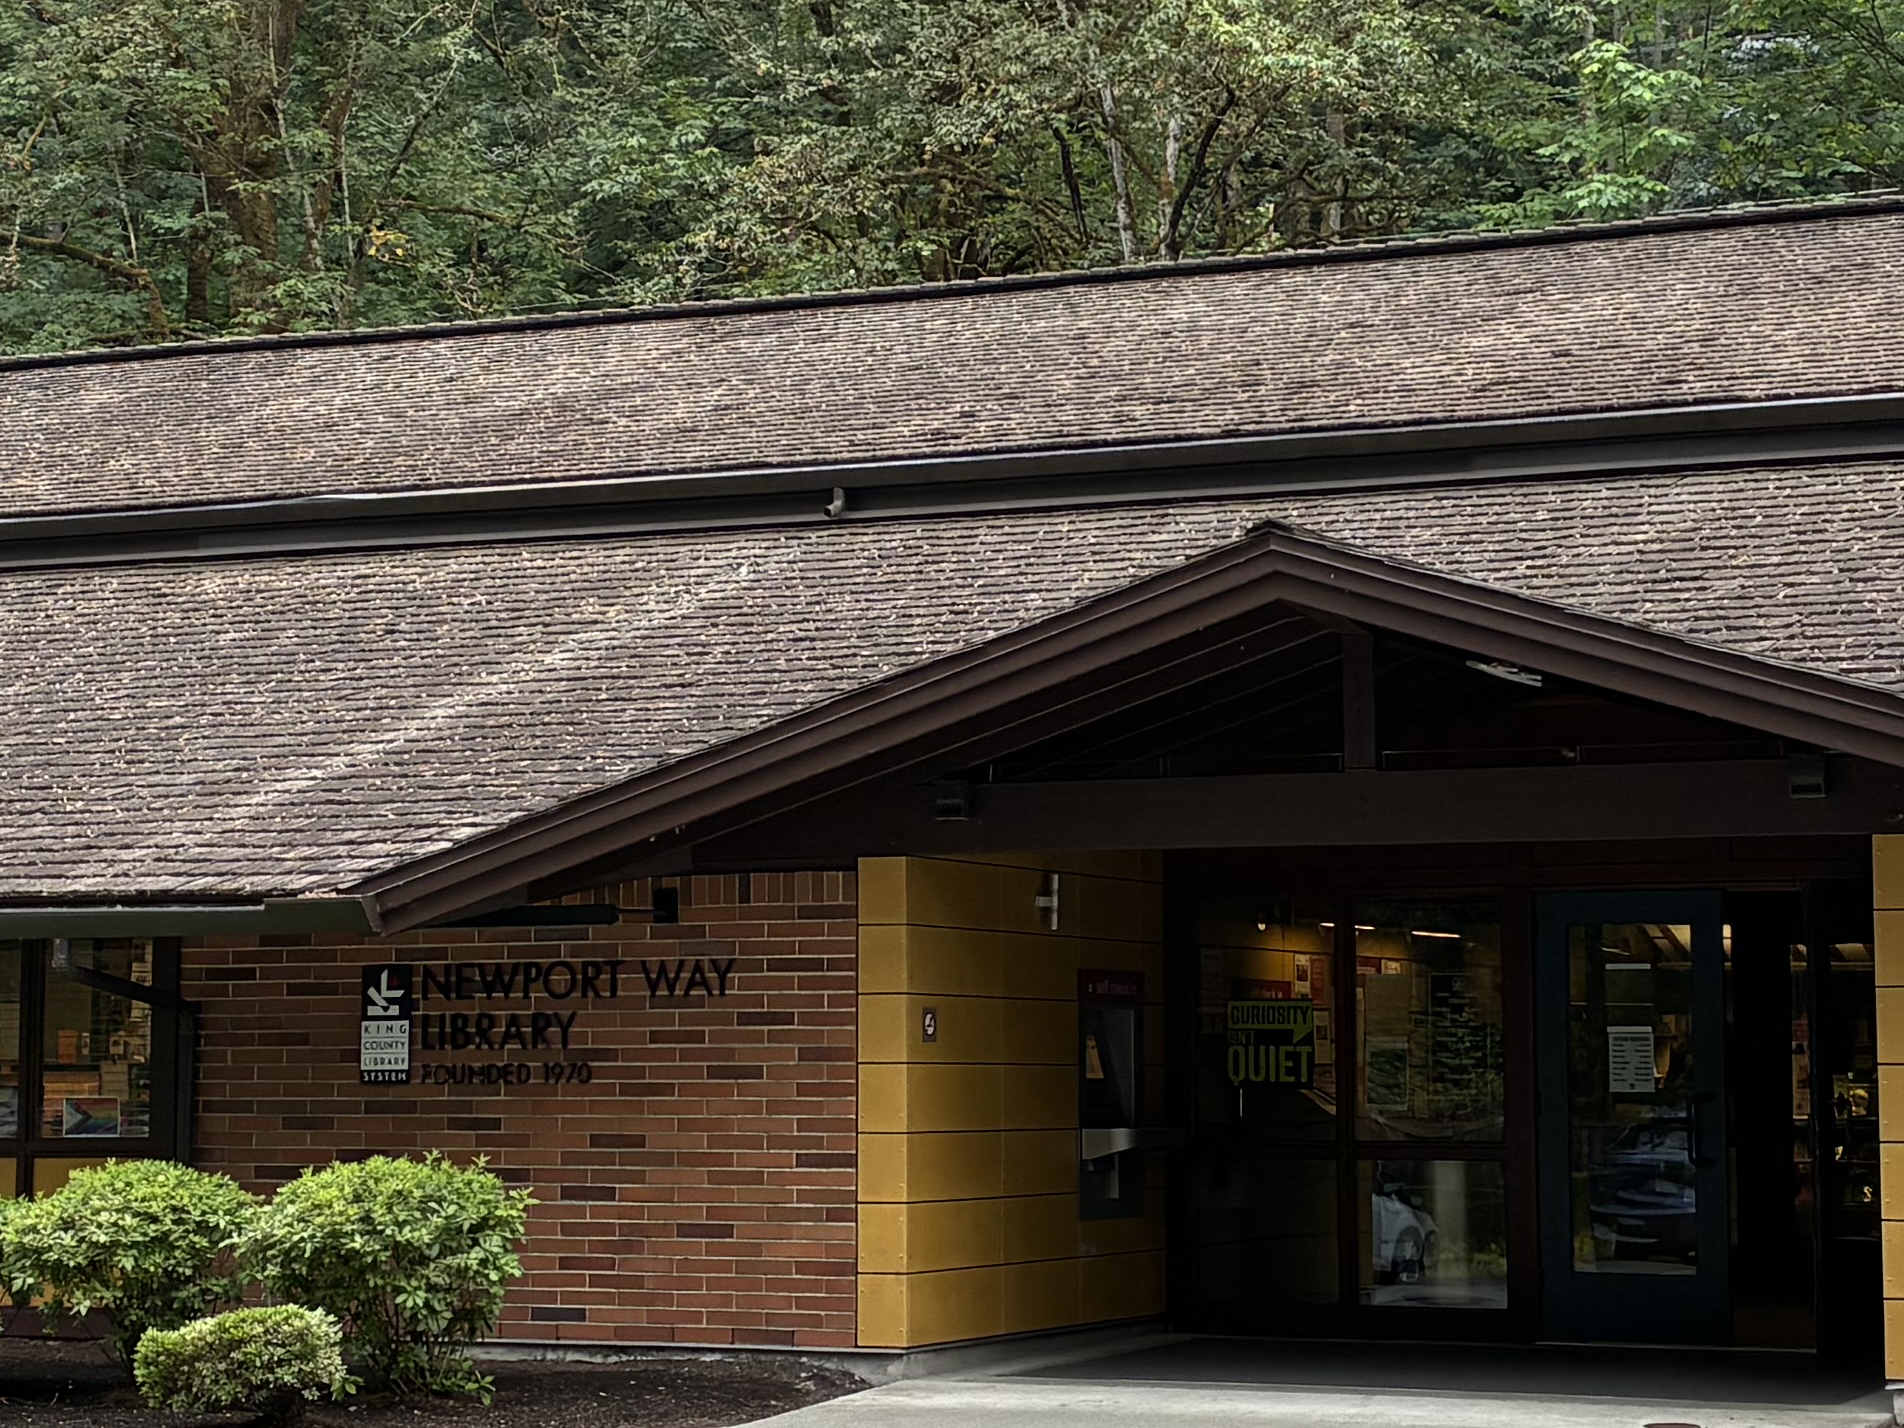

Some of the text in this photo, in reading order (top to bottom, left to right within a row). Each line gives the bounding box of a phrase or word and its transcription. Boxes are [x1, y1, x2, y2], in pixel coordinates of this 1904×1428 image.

[421, 958, 737, 1001] NEWPORT WAY
[1231, 1005, 1310, 1025] CURIOSITY
[364, 1024, 407, 1034] KING
[420, 1011, 577, 1051] LIBRARY
[363, 1041, 406, 1051] COUNTY
[364, 1057, 406, 1067] LIBRARY
[1227, 1045, 1313, 1086] QUIET
[362, 1072, 407, 1082] SYSTEM
[420, 1062, 593, 1085] FOUNDED 1970
